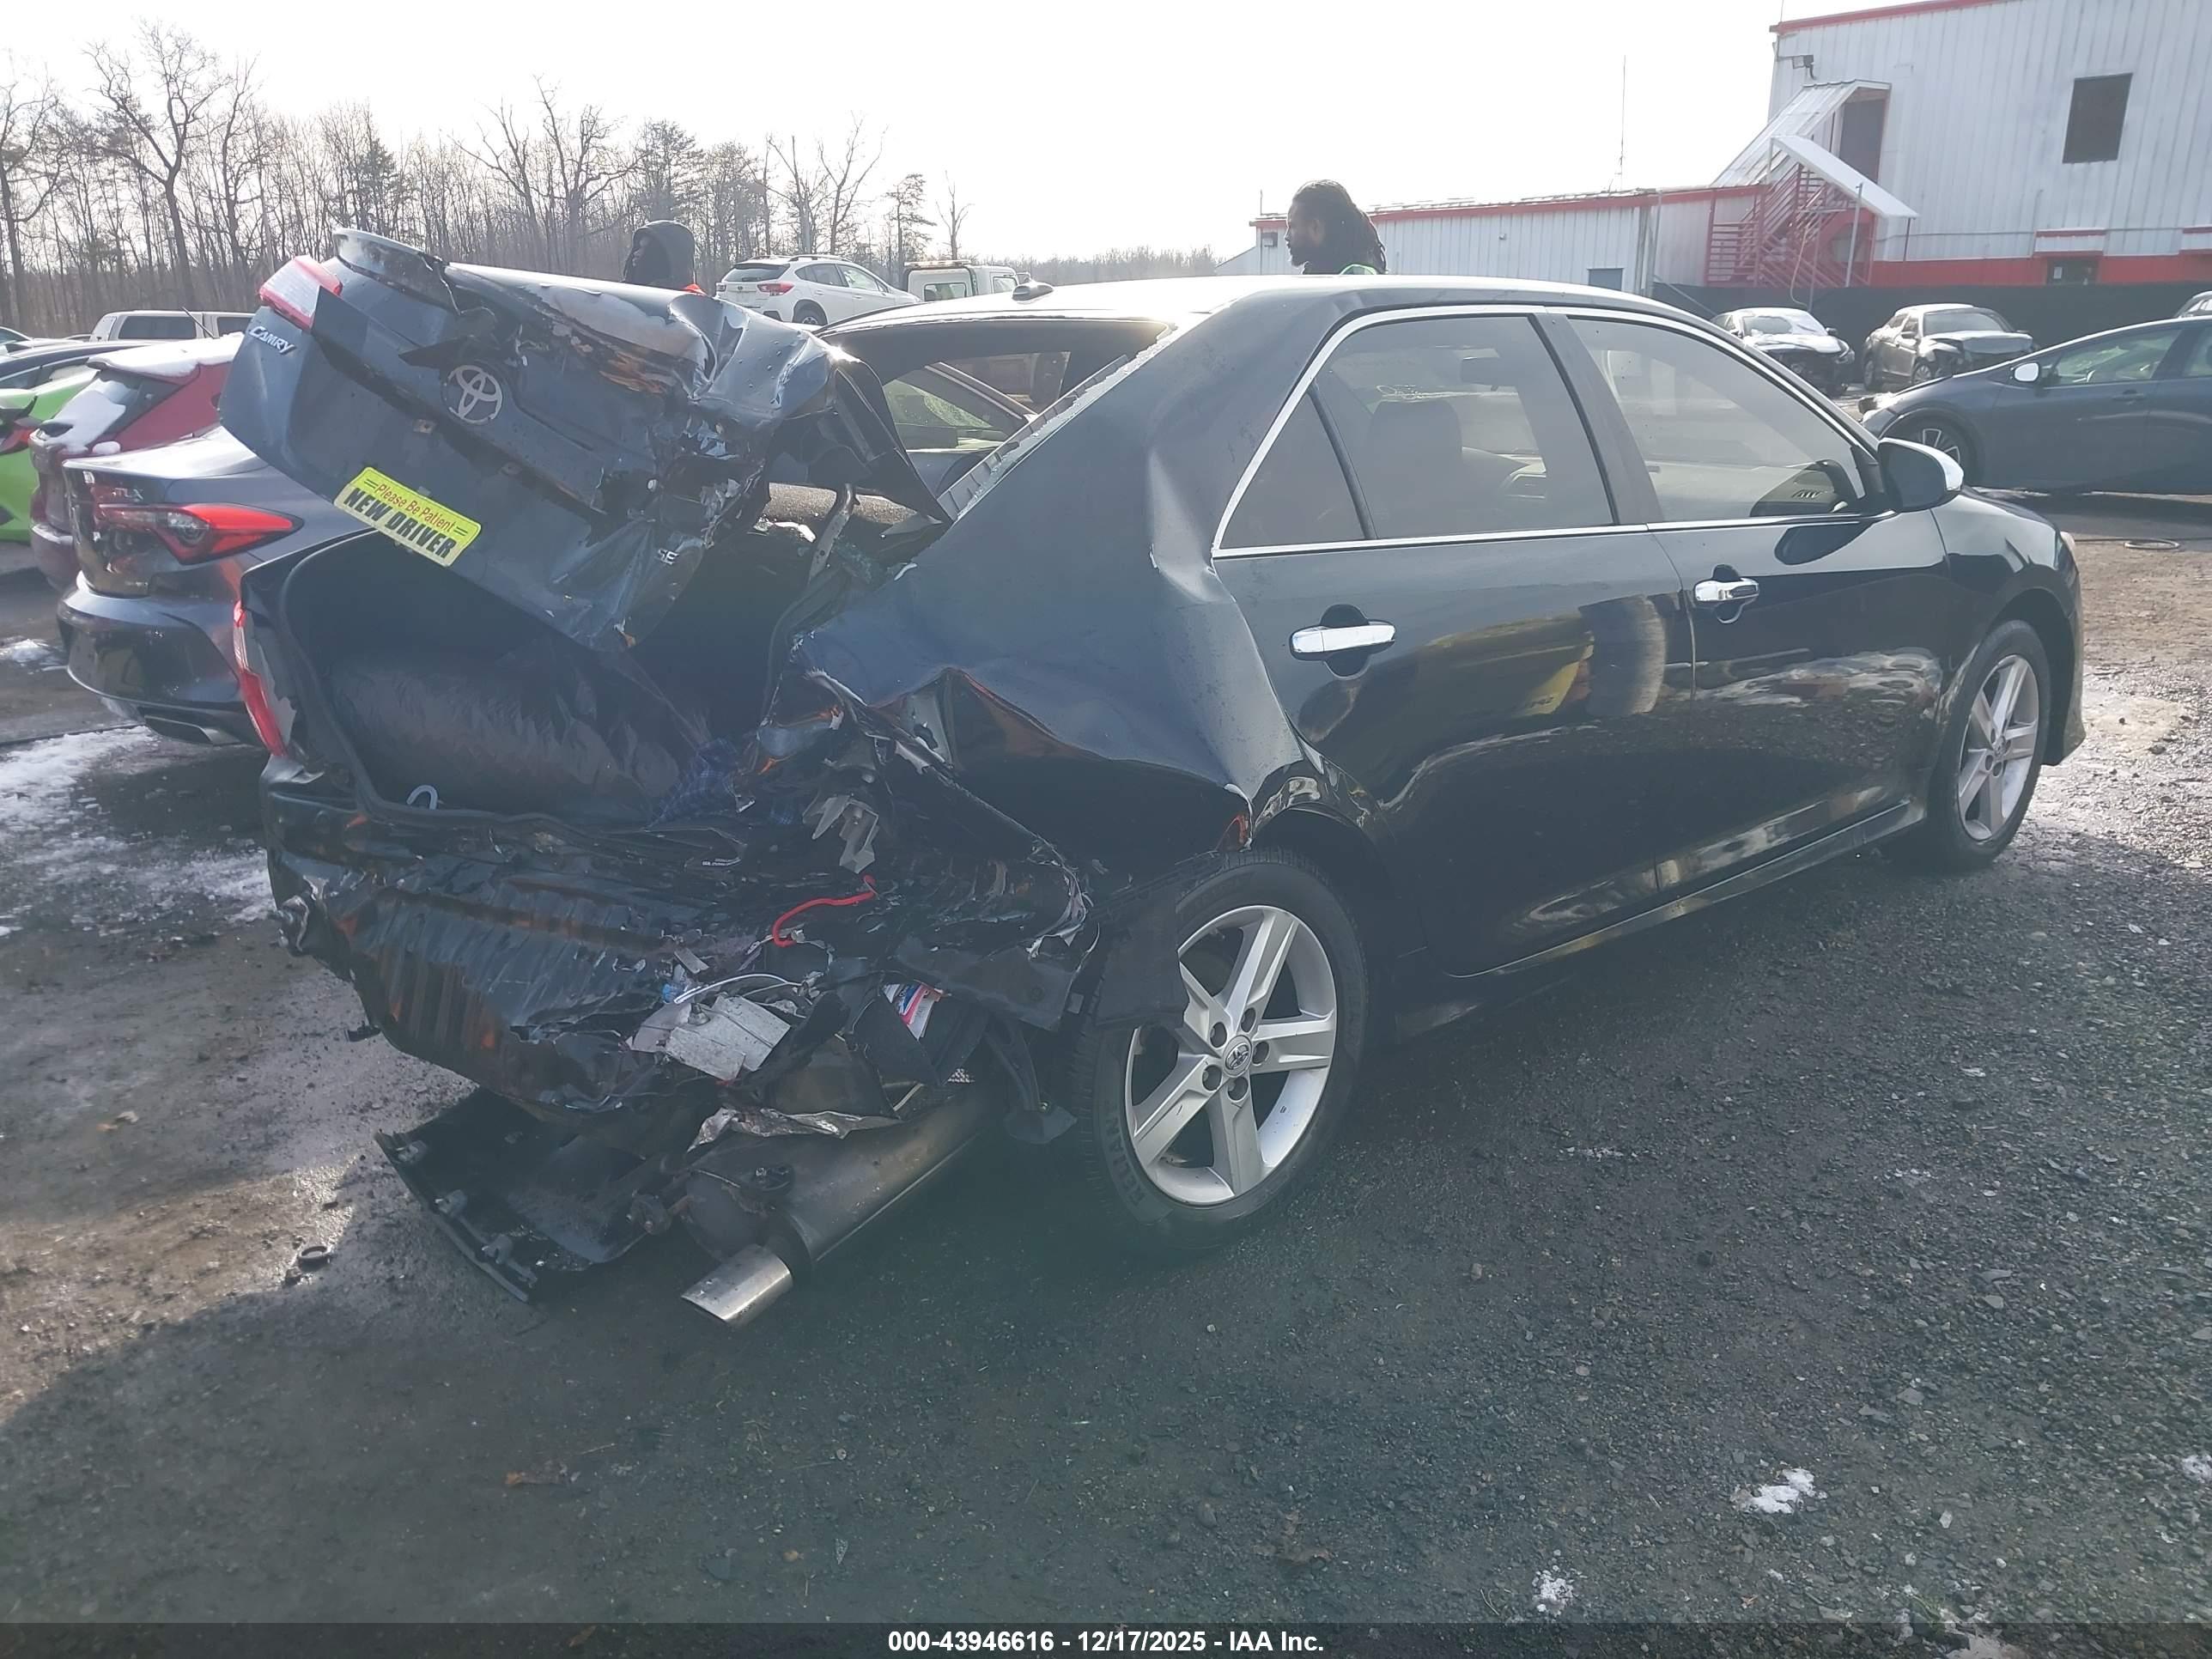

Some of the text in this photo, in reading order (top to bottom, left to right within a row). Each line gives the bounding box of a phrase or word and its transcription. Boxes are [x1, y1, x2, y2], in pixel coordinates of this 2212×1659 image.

[249, 326, 295, 354] CAMRY
[344, 487, 457, 558] NEW DRIVER
[375, 483, 455, 532] Please Be Patient
[658, 549, 679, 565] SE
